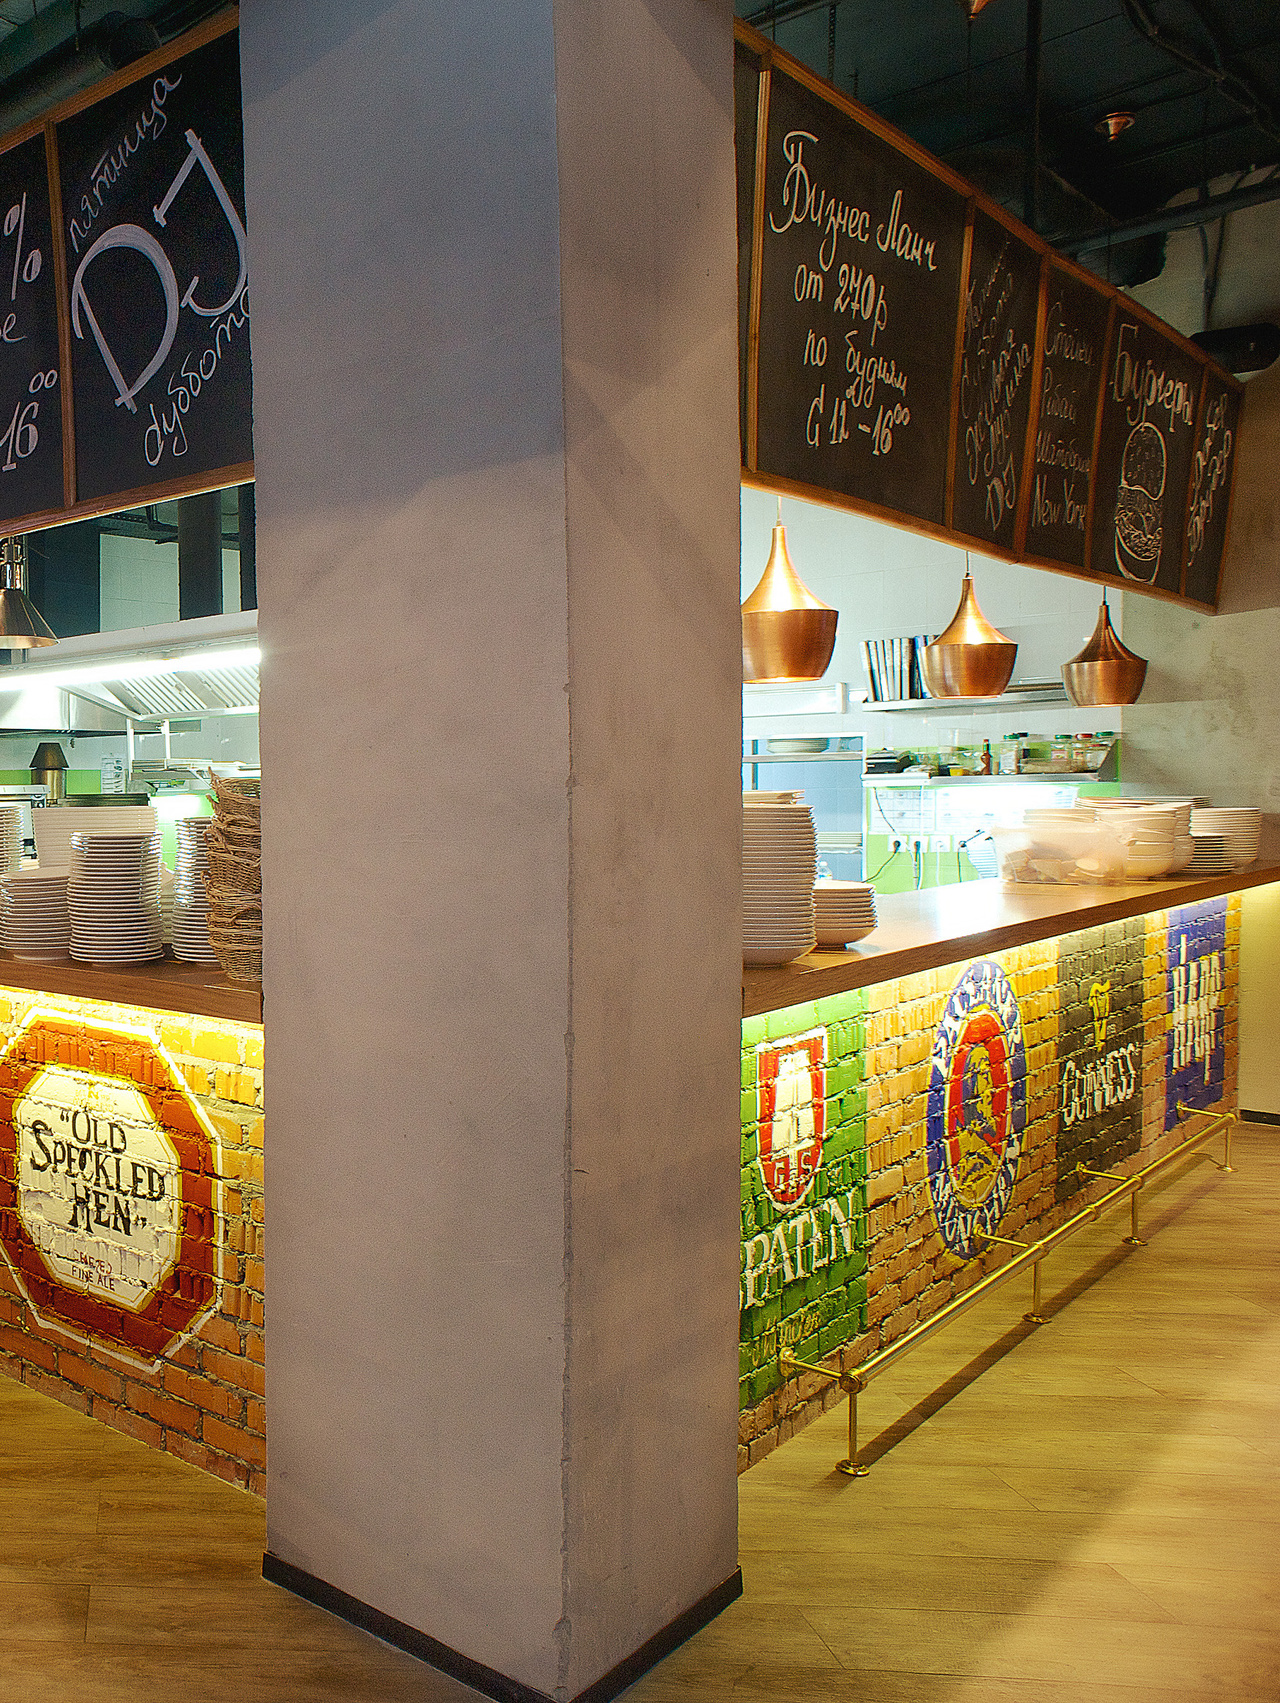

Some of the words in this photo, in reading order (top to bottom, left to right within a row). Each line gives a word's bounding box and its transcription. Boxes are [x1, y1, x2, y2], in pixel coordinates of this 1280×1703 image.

[72, 129, 250, 414] DJ
[1032, 474, 1062, 528] New
[30, 1120, 166, 1201] SPECKLED
[97, 1273, 116, 1291] ALE
[740, 1187, 855, 1310] PATEN
